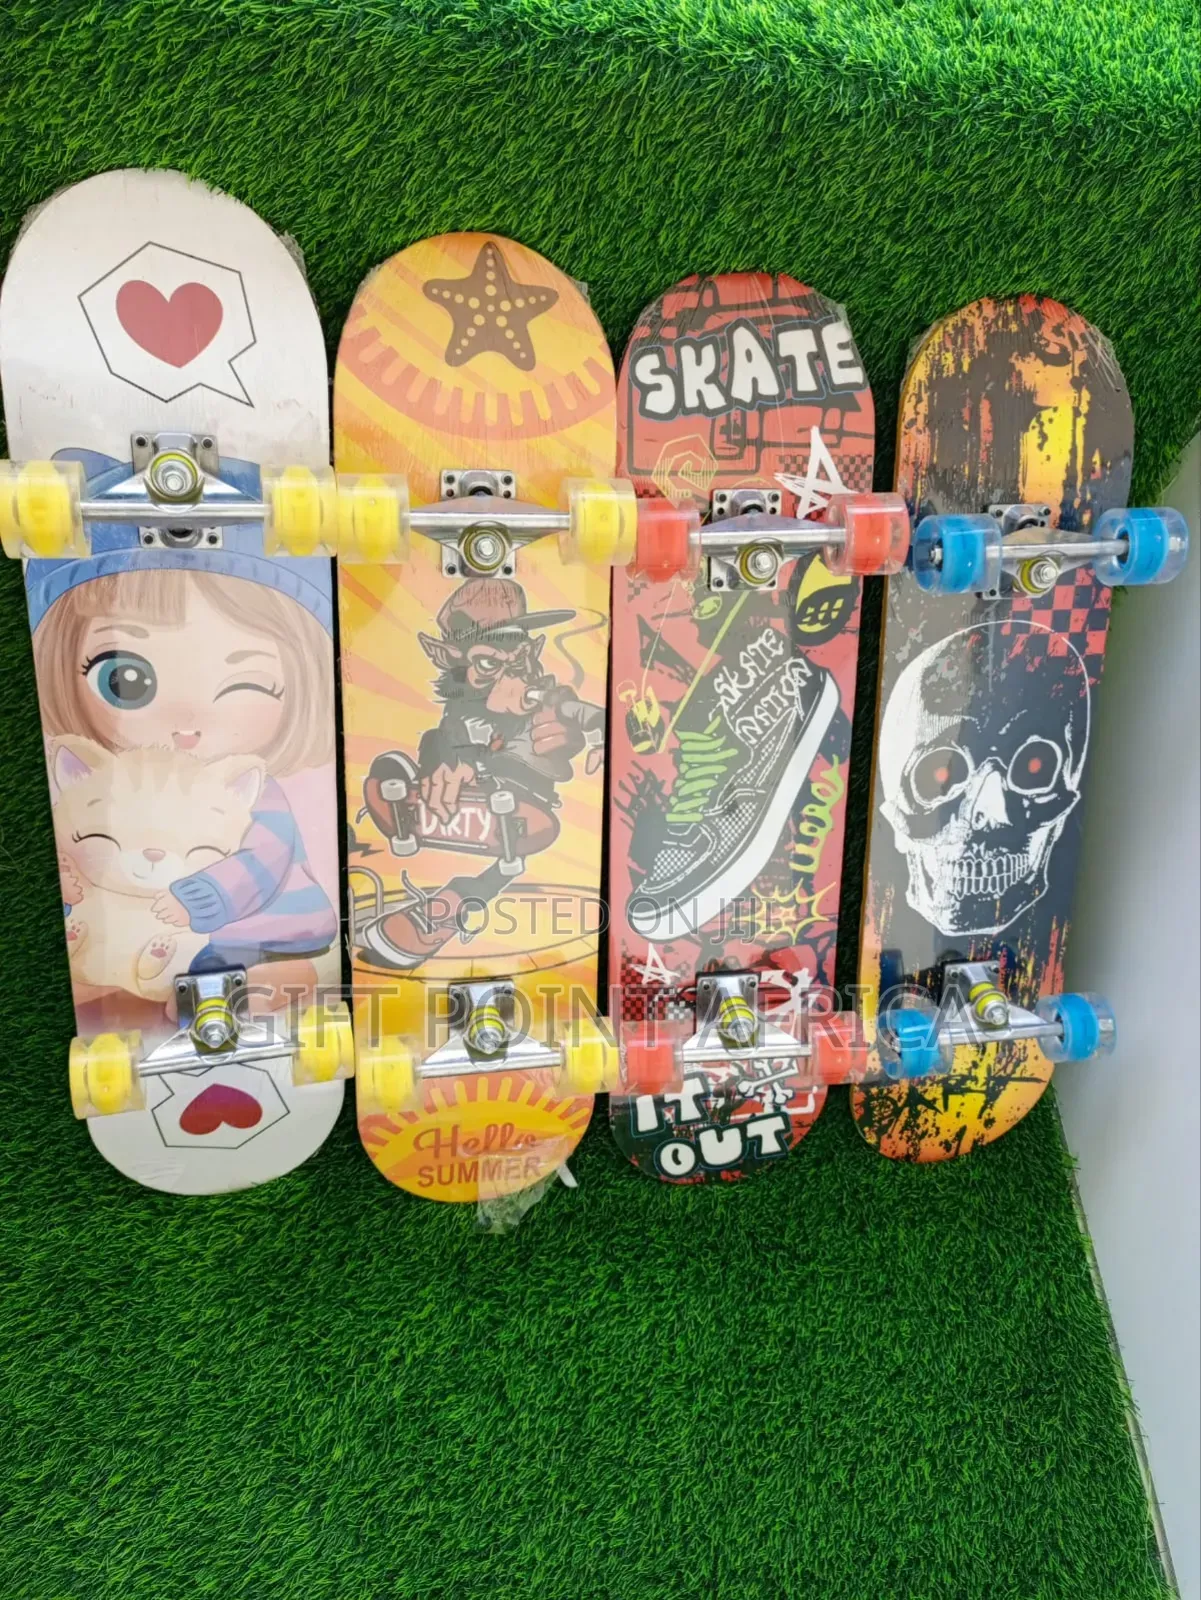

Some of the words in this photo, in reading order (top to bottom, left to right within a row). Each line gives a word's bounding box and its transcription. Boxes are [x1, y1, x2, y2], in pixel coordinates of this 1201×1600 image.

[634, 319, 864, 415] SKATE
[713, 628, 784, 709] SKATE
[735, 657, 813, 745] NATION
[636, 1077, 704, 1132] IT
[413, 1122, 538, 1159] Hello
[660, 1117, 786, 1176] OUT
[417, 1156, 542, 1188] SUMMER
